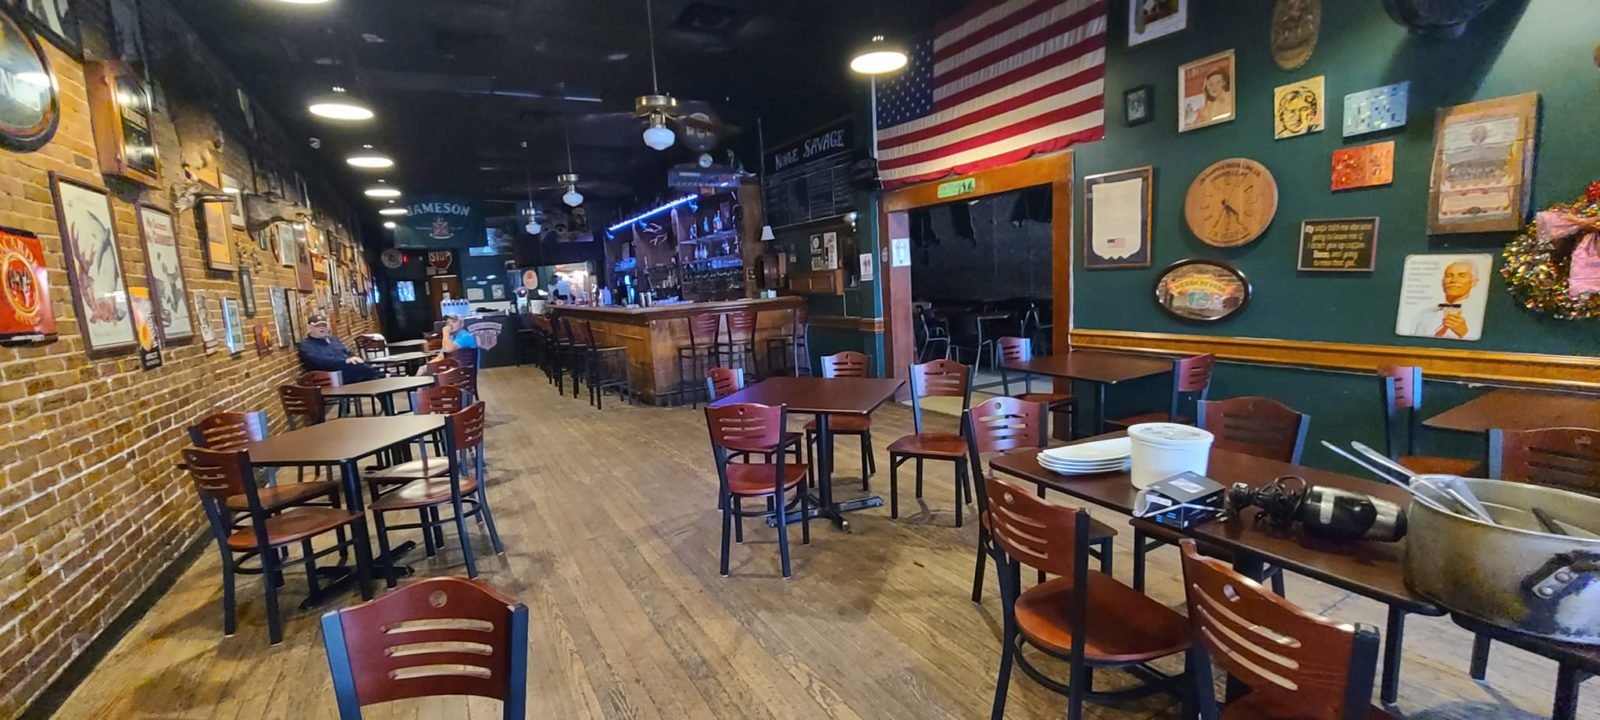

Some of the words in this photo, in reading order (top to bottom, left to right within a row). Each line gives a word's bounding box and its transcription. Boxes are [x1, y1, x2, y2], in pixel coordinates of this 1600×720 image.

[803, 129, 845, 158] SAVAGE
[406, 202, 471, 216] JAMESON
[430, 251, 450, 262] STOP
